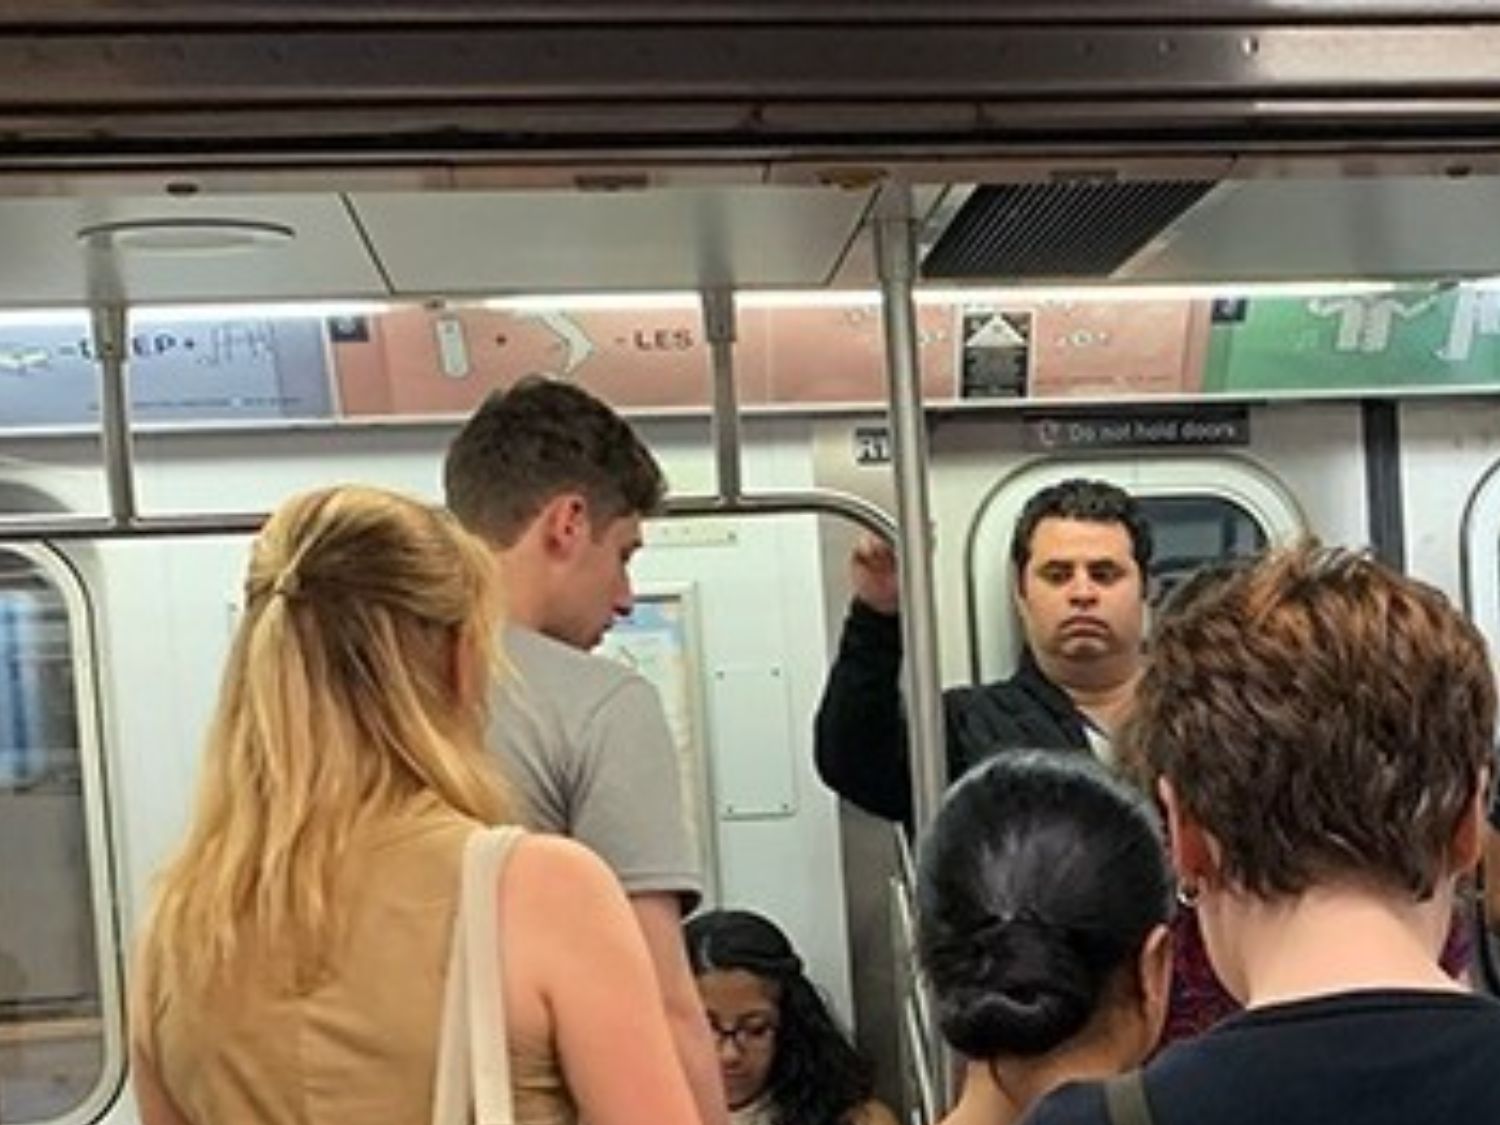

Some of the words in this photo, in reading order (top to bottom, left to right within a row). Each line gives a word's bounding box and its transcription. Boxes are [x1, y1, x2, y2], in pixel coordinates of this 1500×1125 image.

[1069, 421, 1097, 441] Do
[1101, 420, 1131, 441] not
[1135, 419, 1177, 441] hold
[1180, 418, 1236, 440] doors
